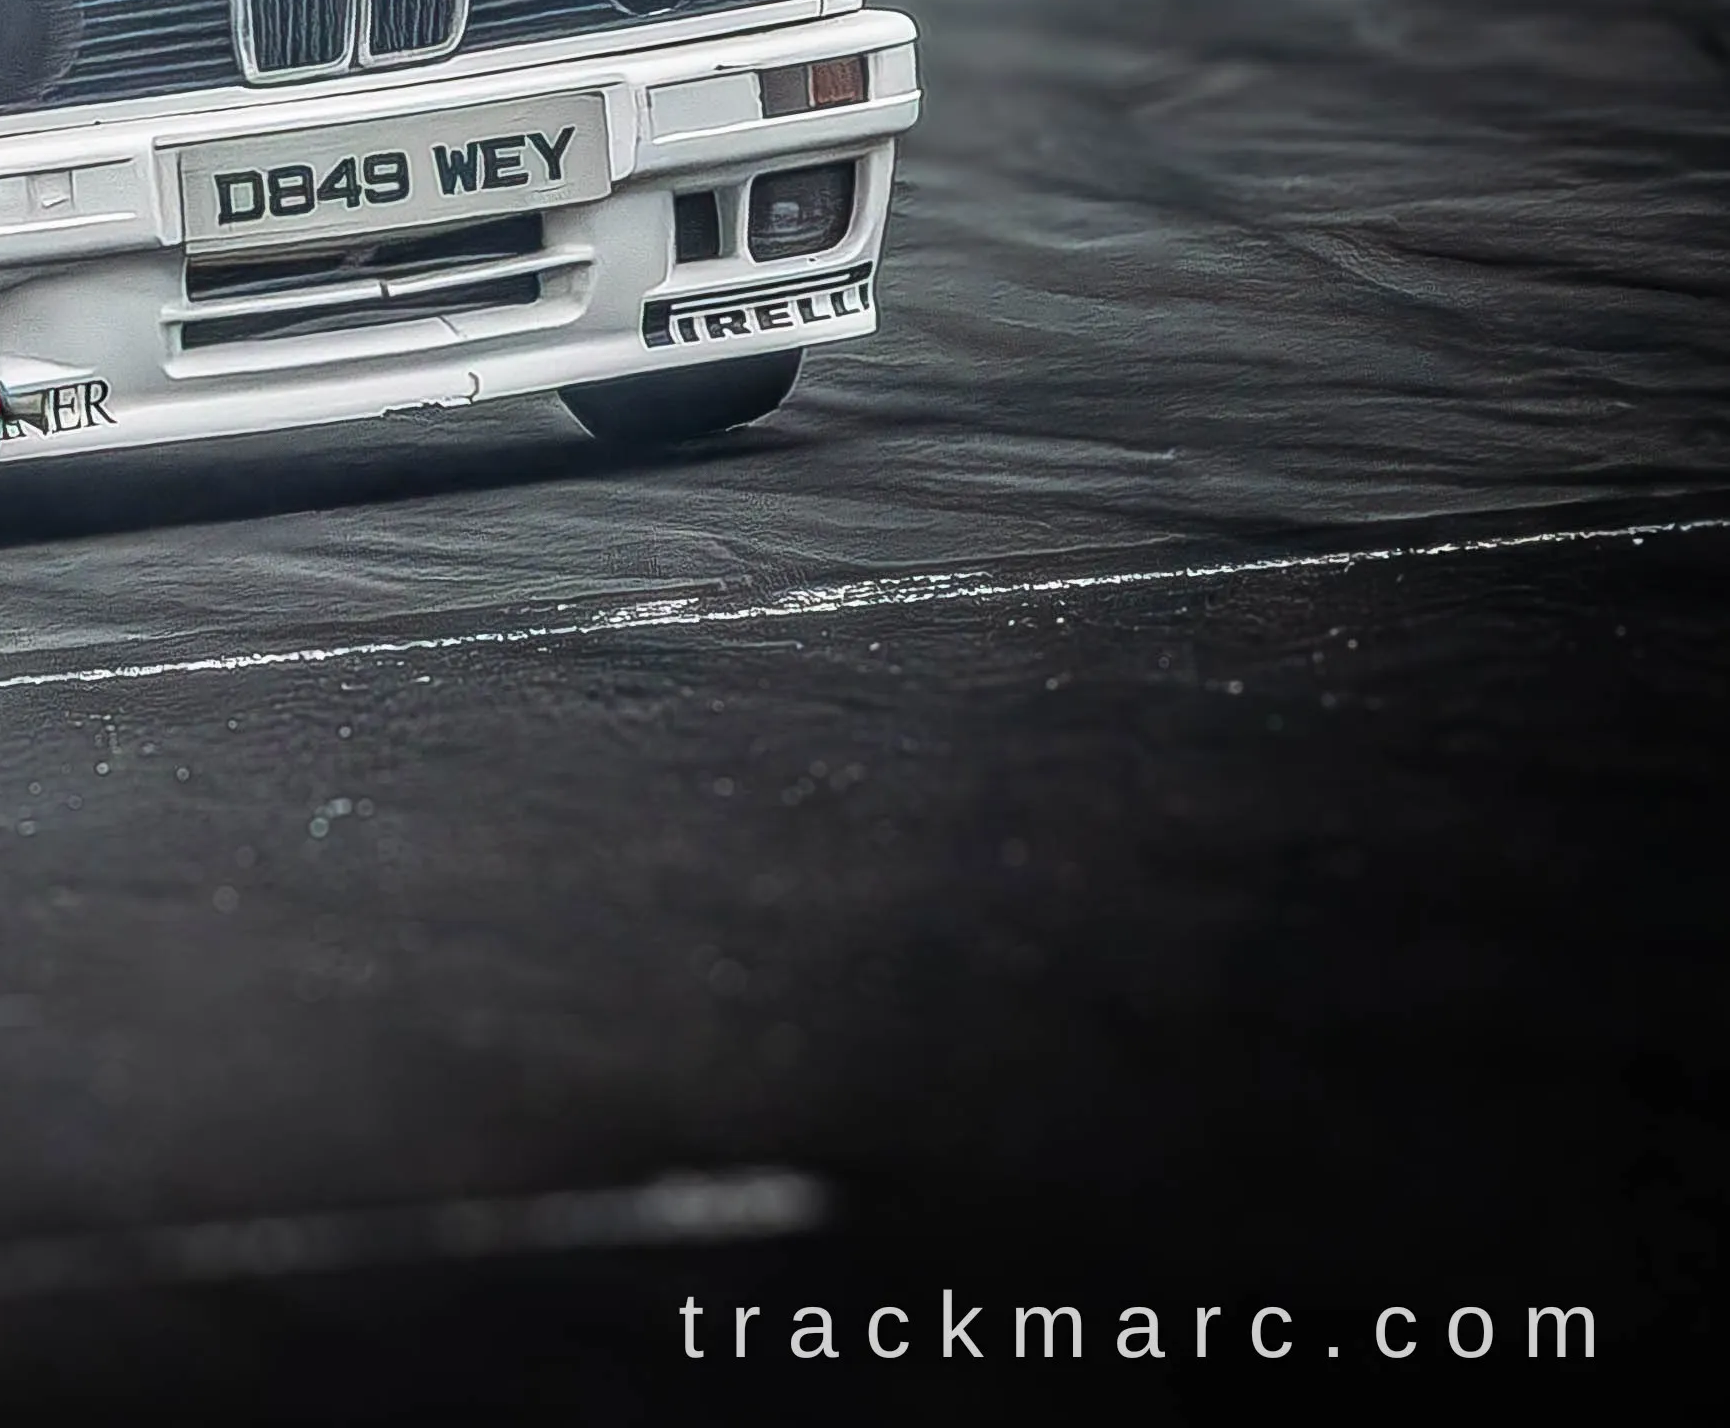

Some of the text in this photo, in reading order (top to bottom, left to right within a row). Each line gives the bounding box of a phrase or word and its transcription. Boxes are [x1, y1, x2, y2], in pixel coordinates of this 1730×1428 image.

[214, 125, 578, 226] D849 WEY
[642, 260, 874, 349] PIRELLI
